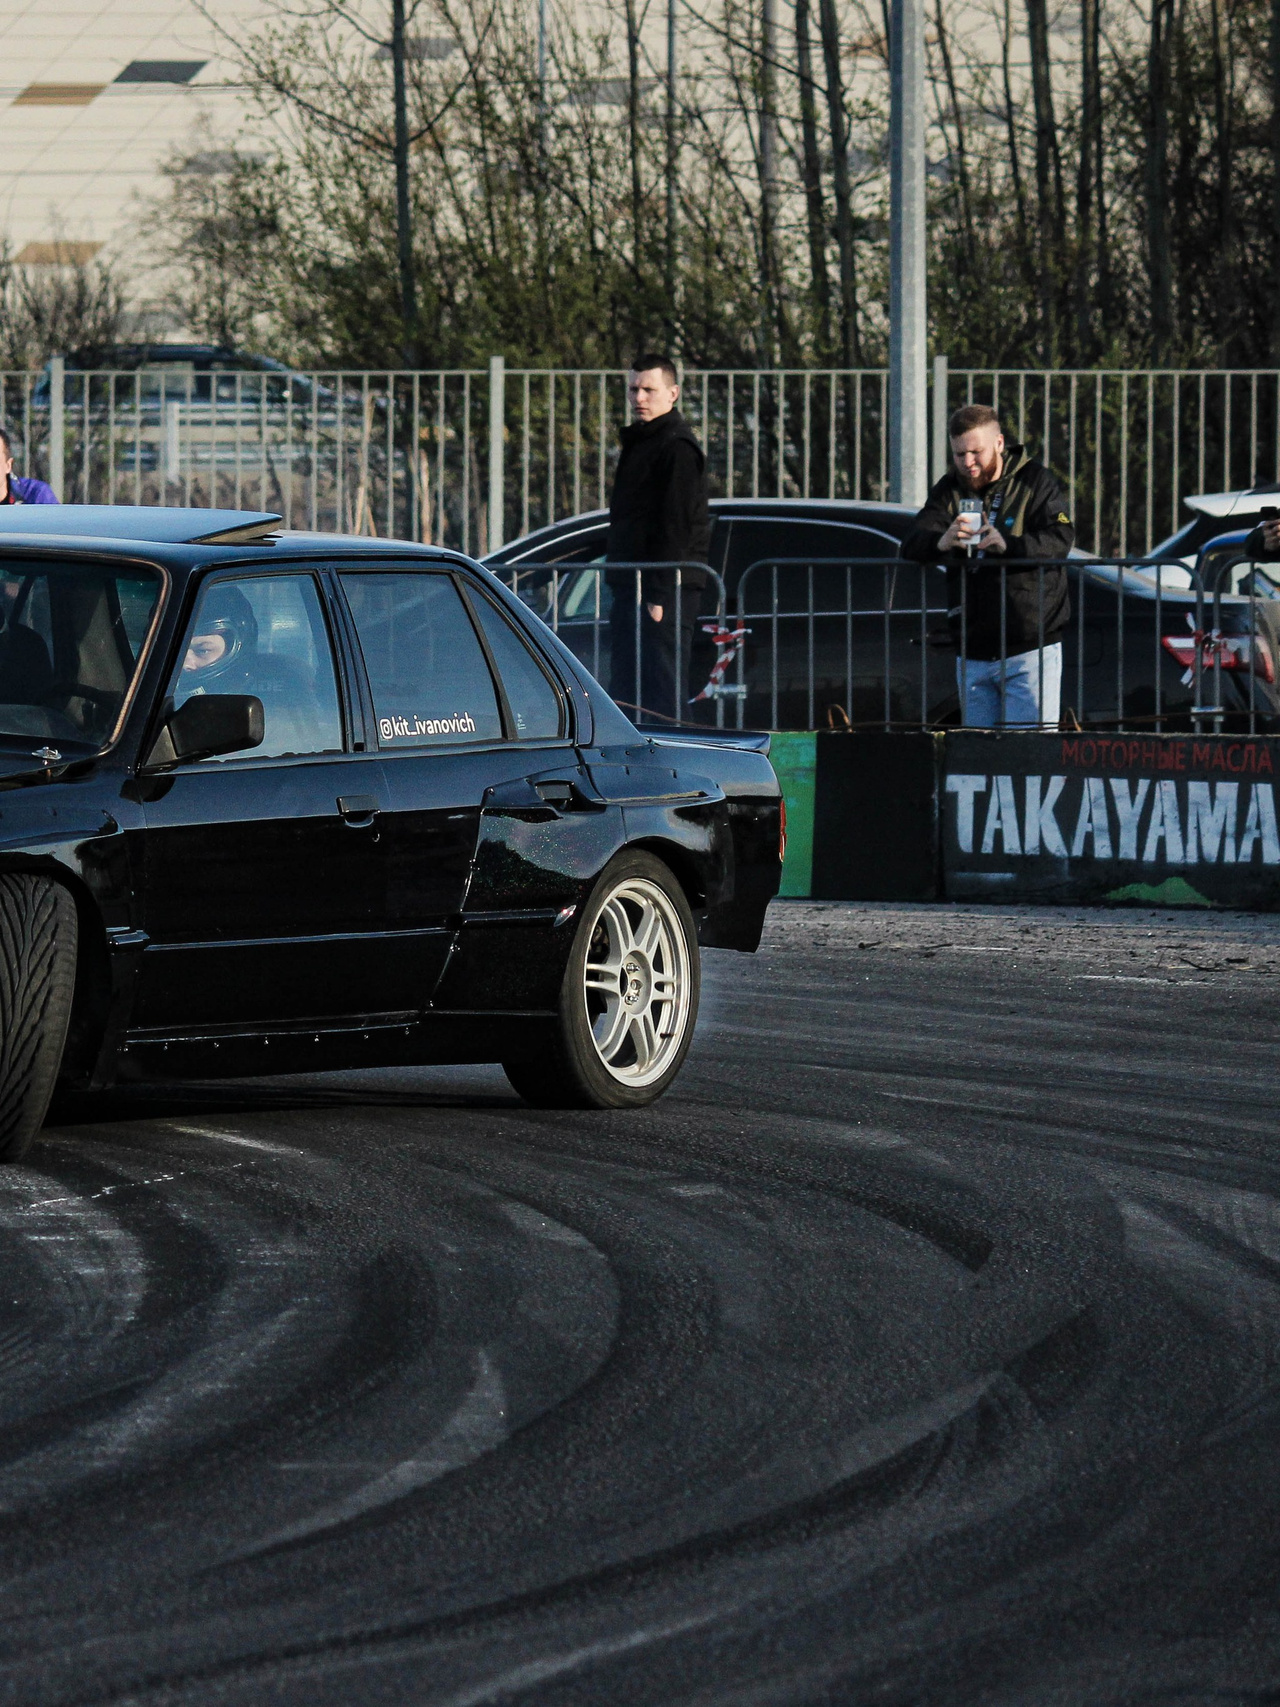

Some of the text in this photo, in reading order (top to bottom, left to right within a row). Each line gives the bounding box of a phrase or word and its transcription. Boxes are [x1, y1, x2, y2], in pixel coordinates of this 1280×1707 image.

[1061, 740, 1273, 773] МОТОРНЫЕ МАСЛА
[945, 774, 1280, 864] TAKAYAMA
